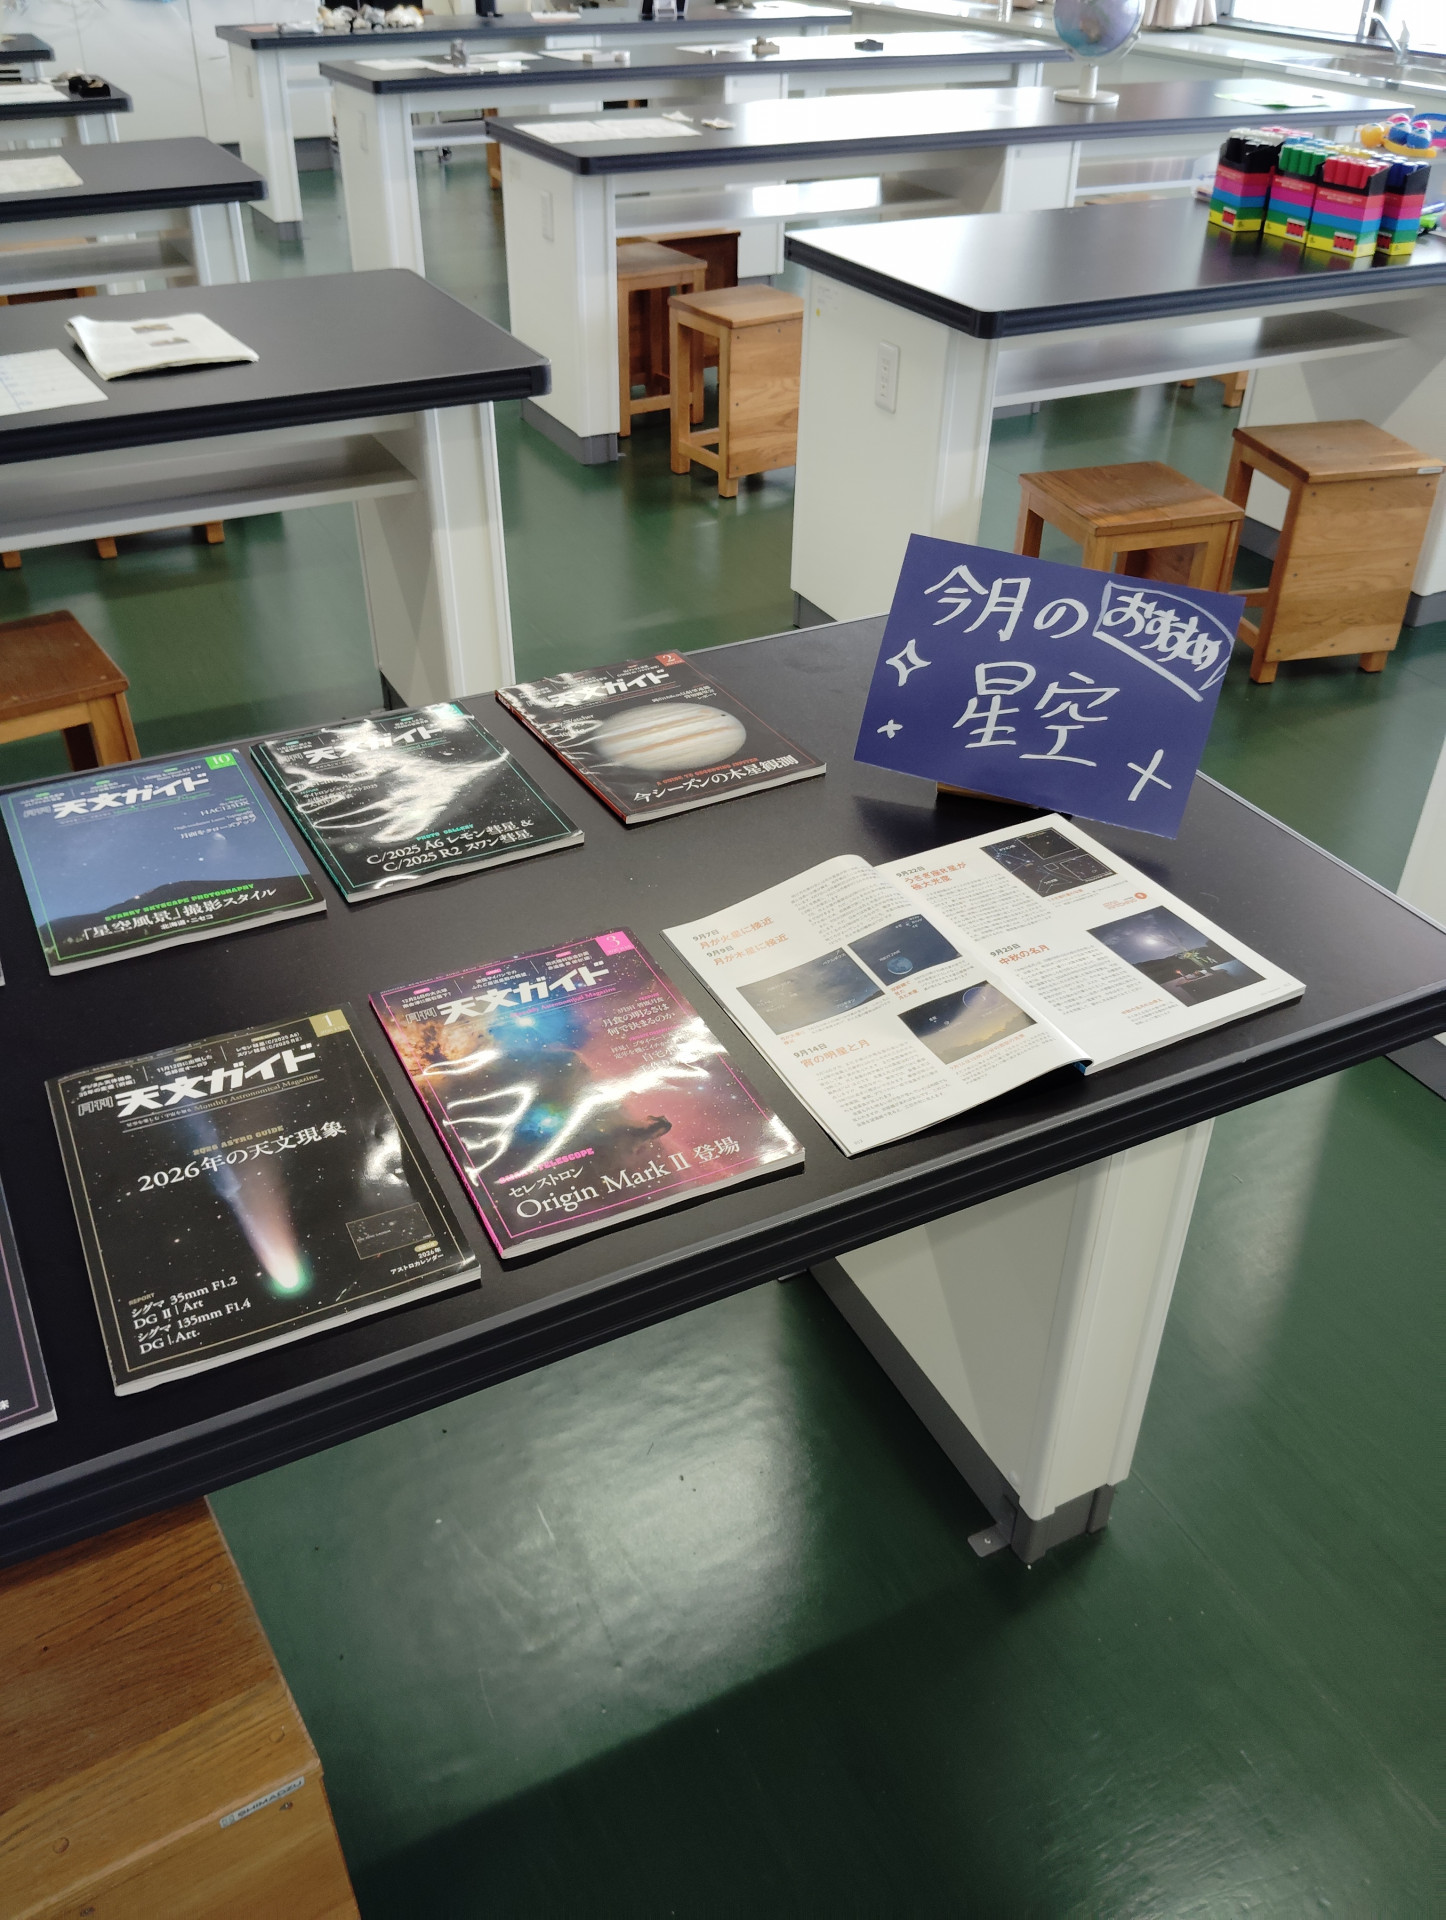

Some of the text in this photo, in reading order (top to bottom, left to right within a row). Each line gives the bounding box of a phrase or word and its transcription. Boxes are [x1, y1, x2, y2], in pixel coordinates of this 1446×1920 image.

[662, 653, 676, 663] 2
[952, 661, 1120, 767] 星空
[211, 754, 230, 764] 10
[634, 755, 799, 802] 今シーズンの木星観測
[53, 772, 209, 819] 天文ガイド
[366, 844, 421, 865] C/2025
[425, 838, 445, 850] A6
[446, 821, 519, 844] レモン彗星
[383, 829, 533, 872] C/2025 R2 スワン彗星
[605, 935, 621, 947] 3
[700, 916, 774, 949] 月が火星に接近
[713, 934, 789, 966] 月が木星に接近
[998, 944, 1050, 965] 中秋の名月
[437, 960, 609, 1026] 天文ガイド
[322, 1014, 333, 1026] 1
[602, 1003, 670, 1027] 月食の明るさは
[115, 1043, 316, 1117] 天文ガイド
[193, 1073, 319, 1111] Monthly Astronomical Magazine
[254, 1125, 285, 1138] GUIDE
[135, 1119, 347, 1192] 2026年の天文現象
[537, 1148, 594, 1171] TELESCOPE
[508, 1166, 584, 1198] セレストロン
[516, 1185, 600, 1218] Origin
[600, 1161, 669, 1193] Mark
[693, 1136, 740, 1164] 登場
[390, 1252, 445, 1274] アストロカレンダー
[129, 1275, 238, 1317] シグマ 35mm F1.2
[132, 1312, 158, 1329] DG
[181, 1298, 203, 1312] Art
[135, 1297, 252, 1342] シグマ 135mm F1.4
[138, 1327, 197, 1354] DG Art
[237, 1780, 302, 1818] SHIMADZU
